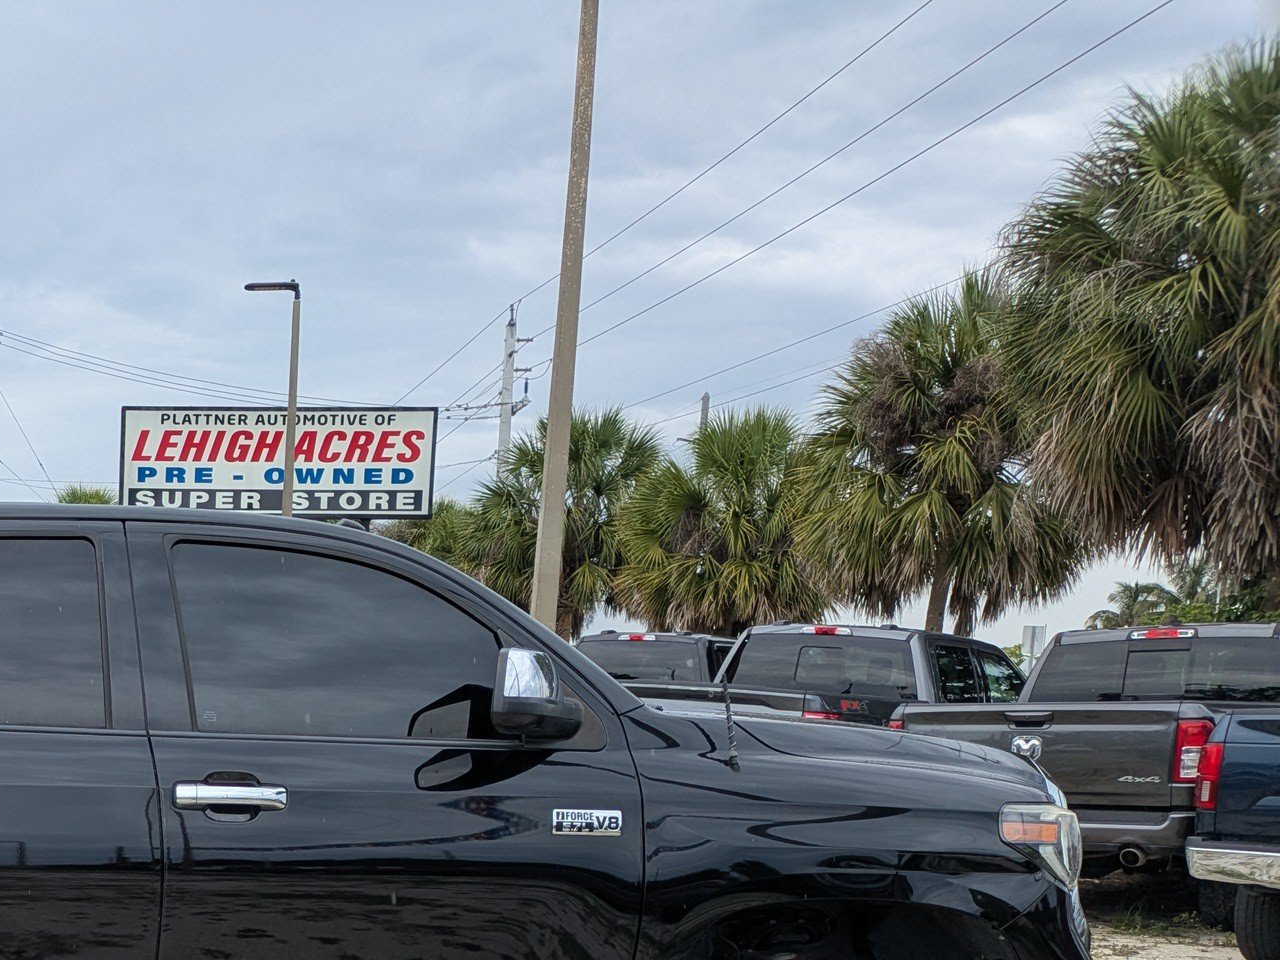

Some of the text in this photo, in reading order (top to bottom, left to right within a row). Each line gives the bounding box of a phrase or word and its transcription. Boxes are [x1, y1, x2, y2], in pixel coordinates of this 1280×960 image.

[160, 413, 249, 426] PLATTNER
[374, 413, 397, 426] OF
[130, 430, 426, 463] LEHIGH ACRES
[137, 466, 214, 483] PRE
[263, 467, 414, 485] OWNED
[135, 490, 416, 510] SUPER STORE
[595, 816, 620, 831] V8
